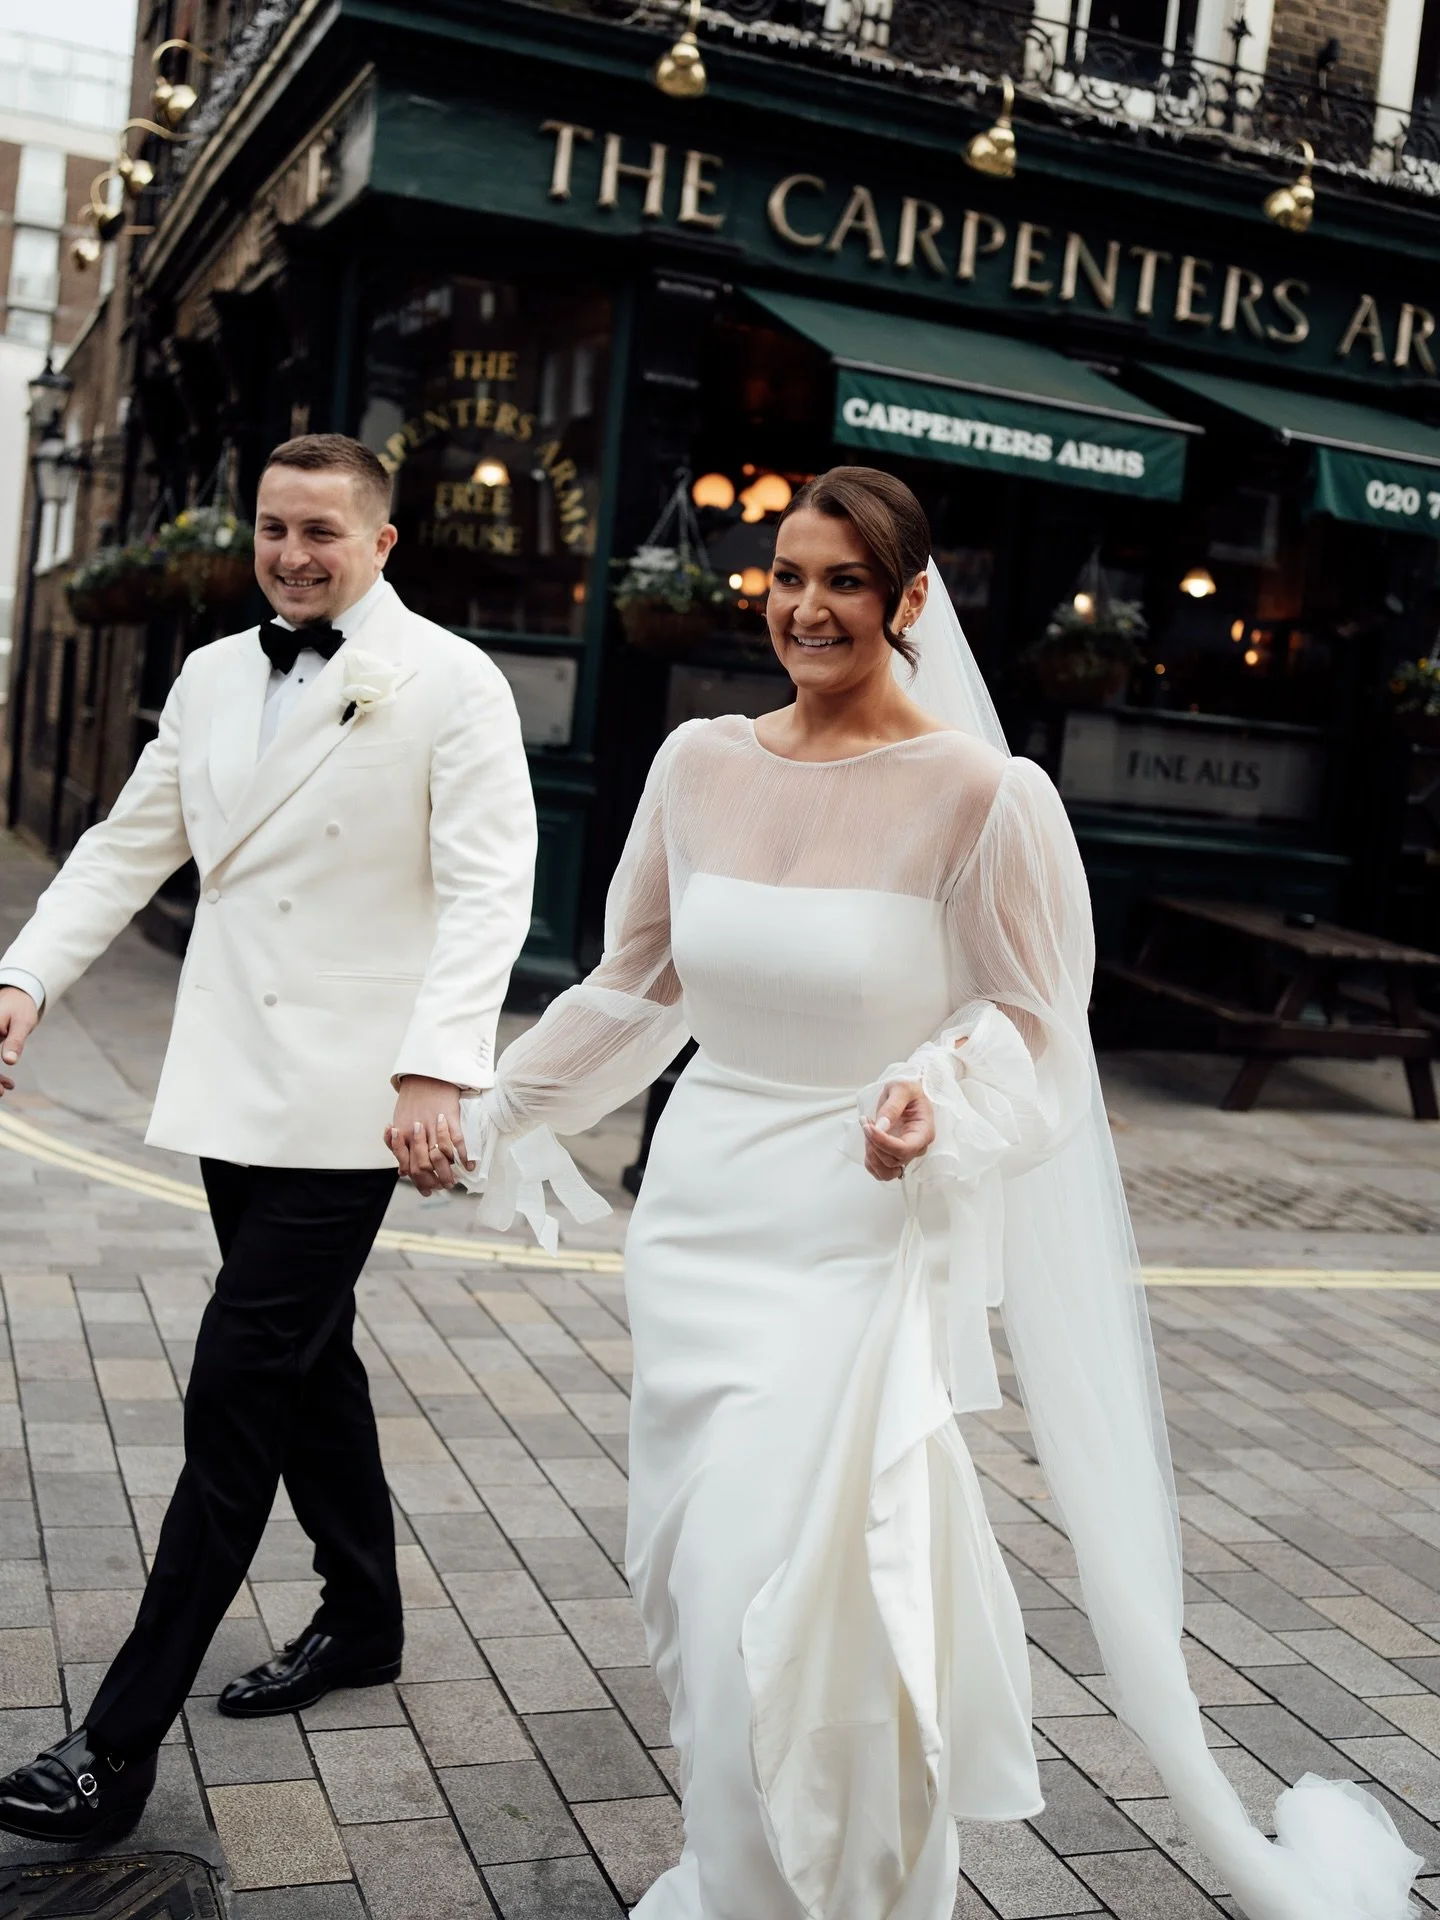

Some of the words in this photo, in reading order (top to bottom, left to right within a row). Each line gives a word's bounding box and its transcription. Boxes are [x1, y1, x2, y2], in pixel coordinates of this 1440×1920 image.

[540, 119, 726, 231] THE
[767, 173, 1310, 345] CARPENTERS
[1337, 293, 1439, 375] AR
[453, 350, 518, 381] THE
[842, 396, 1052, 463] CARPENTERS
[1056, 437, 1145, 479] ARMS
[435, 481, 513, 515] FREE
[535, 440, 587, 545] ARMS
[1365, 479, 1421, 516] 020
[418, 520, 522, 555] HOUSE
[1127, 750, 1190, 784] FINE
[1196, 758, 1261, 791] ALES
